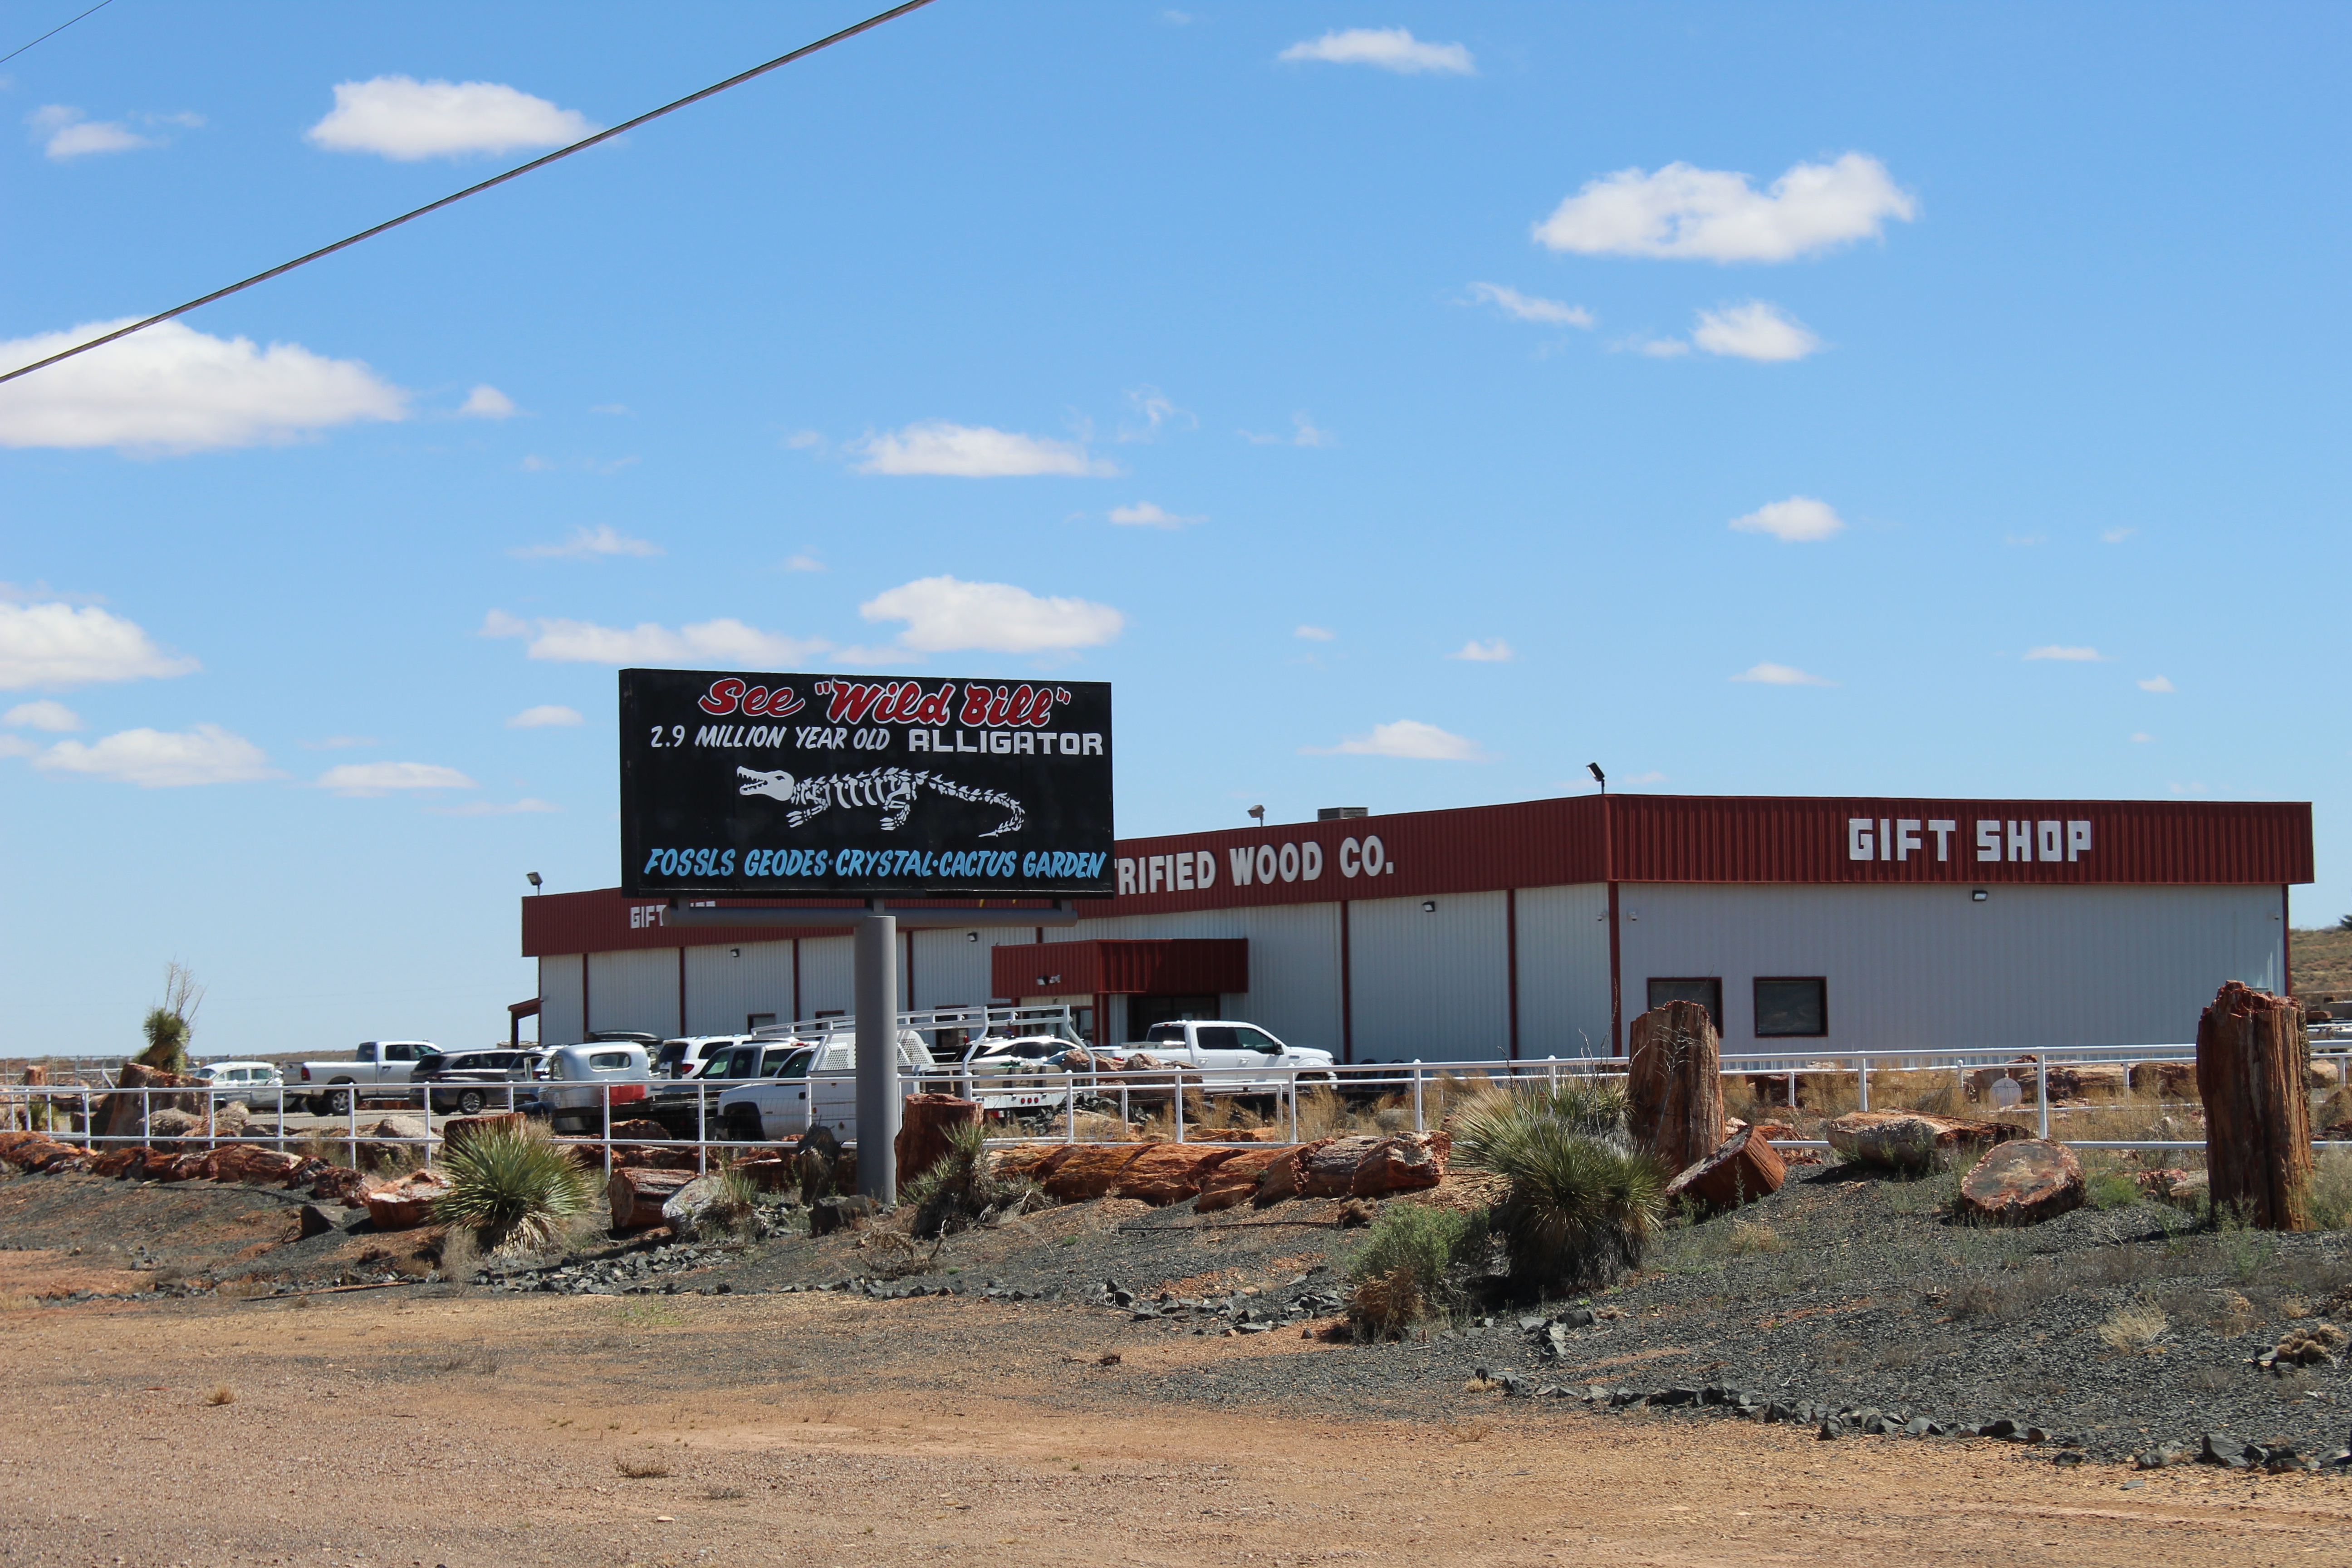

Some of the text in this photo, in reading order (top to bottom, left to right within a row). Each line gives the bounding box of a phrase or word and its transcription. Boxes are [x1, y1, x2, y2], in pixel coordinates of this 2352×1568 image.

[698, 676, 1071, 728] See "Wild Bill"
[651, 725, 1103, 755] 2.9 MILLION YEAR OLD ALLIGATOR
[1848, 818, 2091, 862] GIFT SHOP
[644, 848, 736, 877] FOSSLS
[1023, 851, 1107, 878] GARDEN
[1114, 835, 1394, 895] RIFIED WOOD CO.
[630, 905, 666, 928] GIFT
